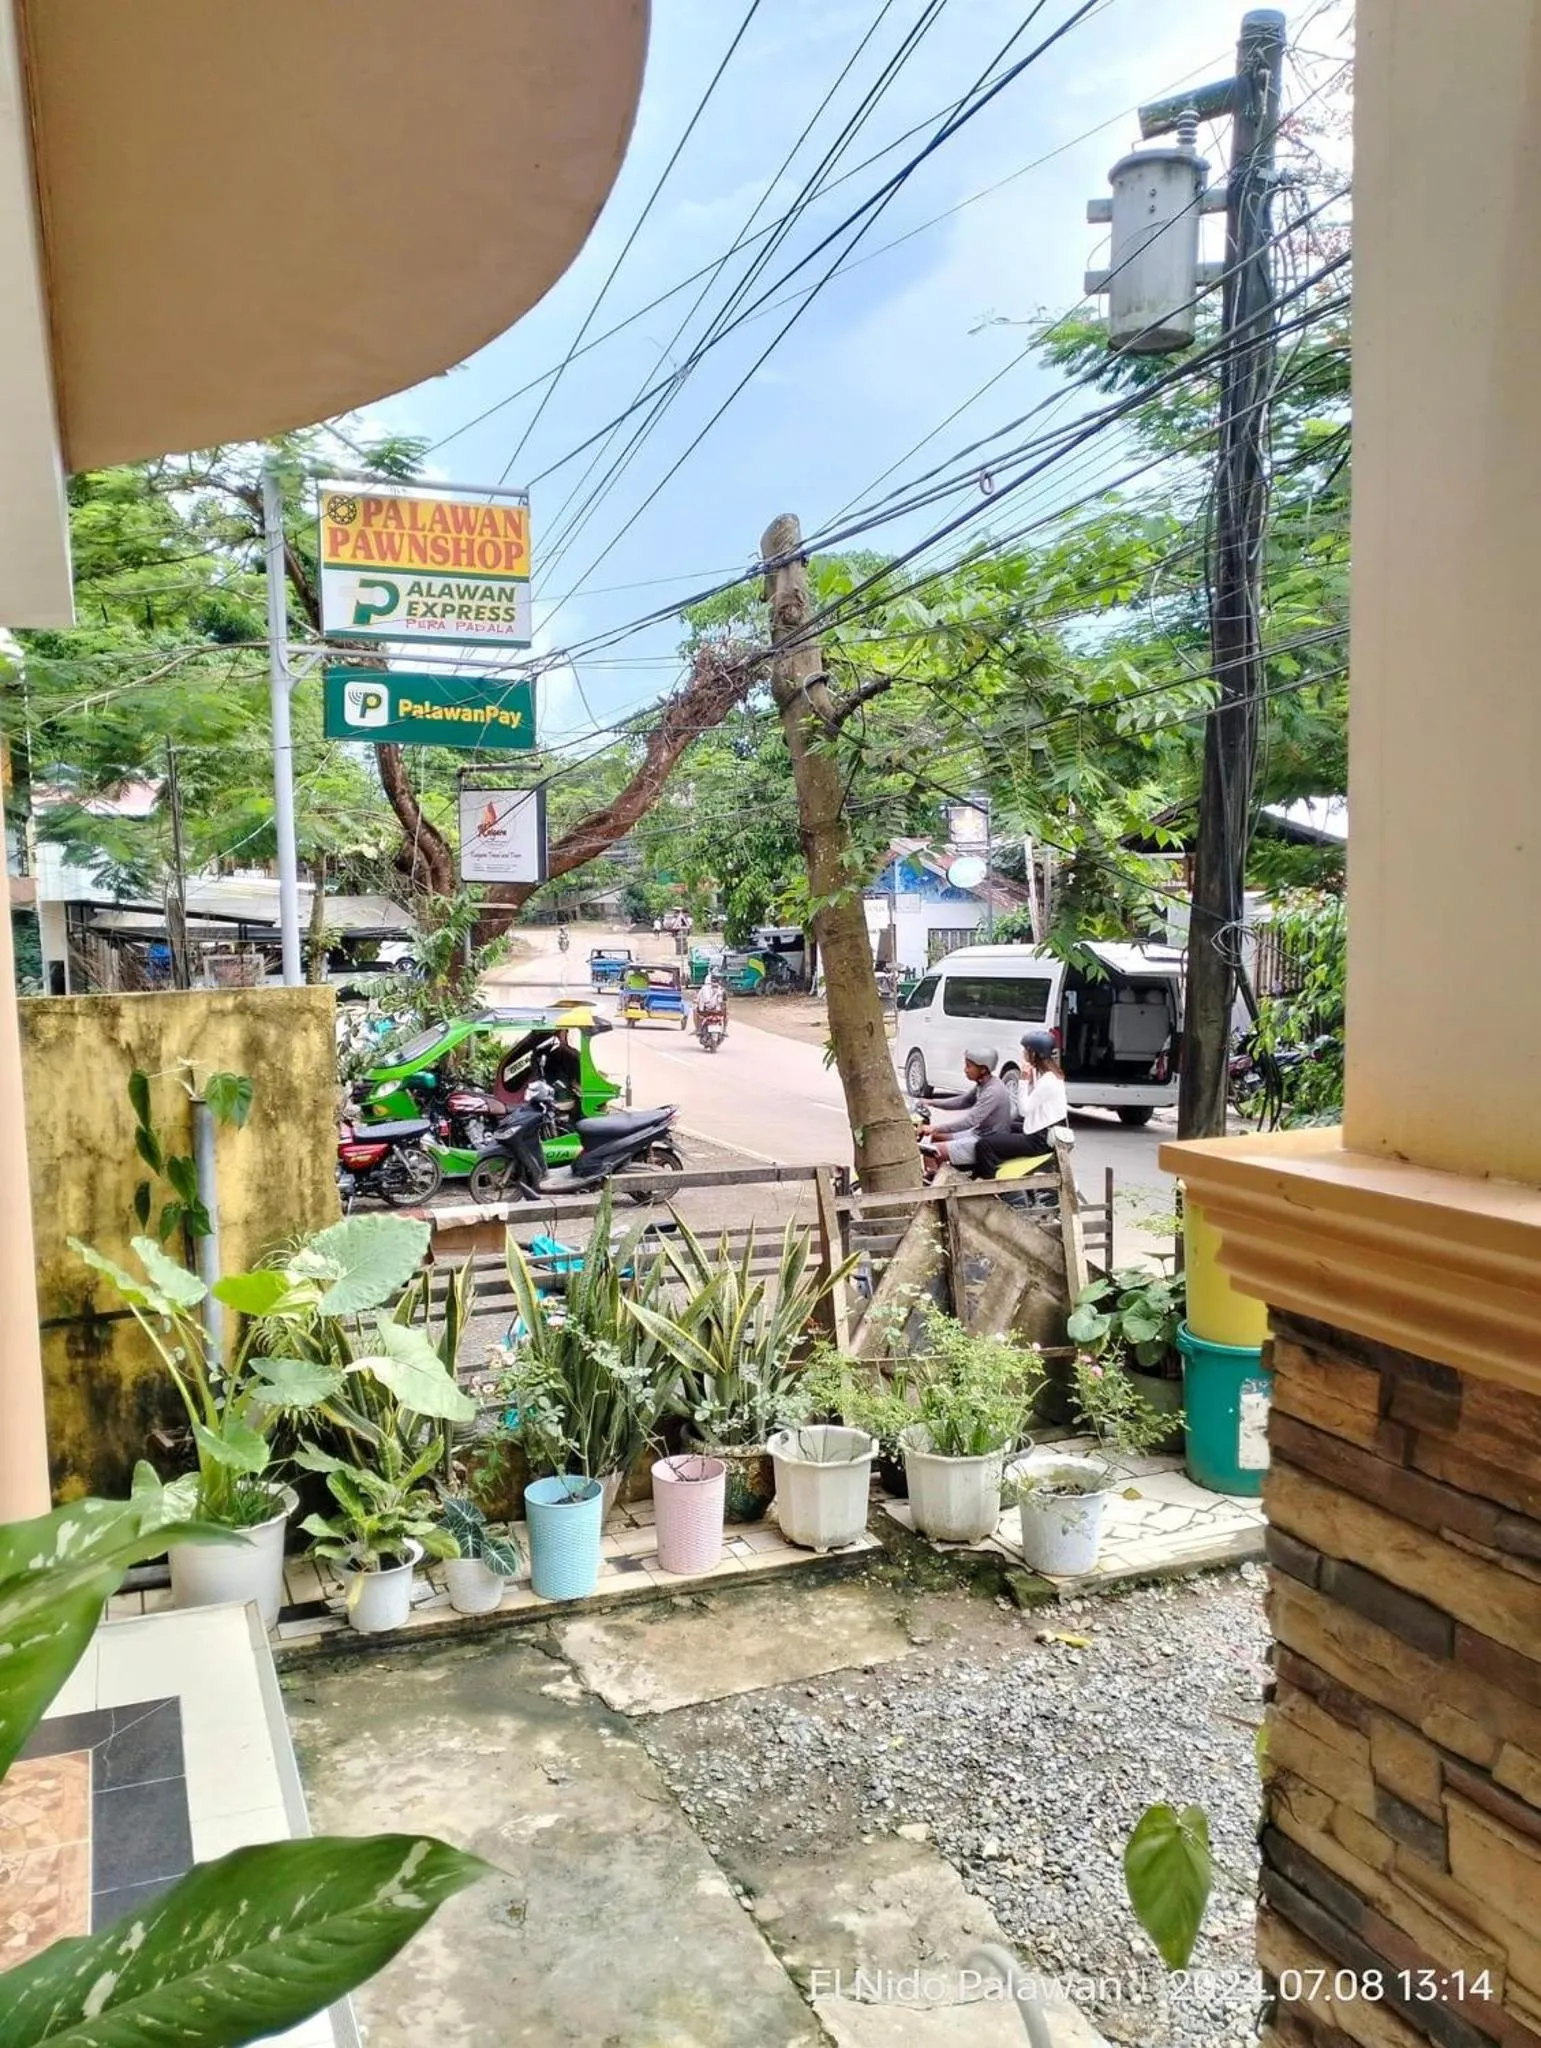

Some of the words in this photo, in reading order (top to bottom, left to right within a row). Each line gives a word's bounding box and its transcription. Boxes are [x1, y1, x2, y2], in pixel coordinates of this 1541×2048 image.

[362, 498, 524, 540] PALAWAN
[327, 527, 524, 570] PAWNSHOP
[406, 601, 516, 622] EXPRESS
[406, 619, 446, 631] PERA
[455, 621, 515, 634] PADALA
[398, 699, 522, 729] PalawanPay
